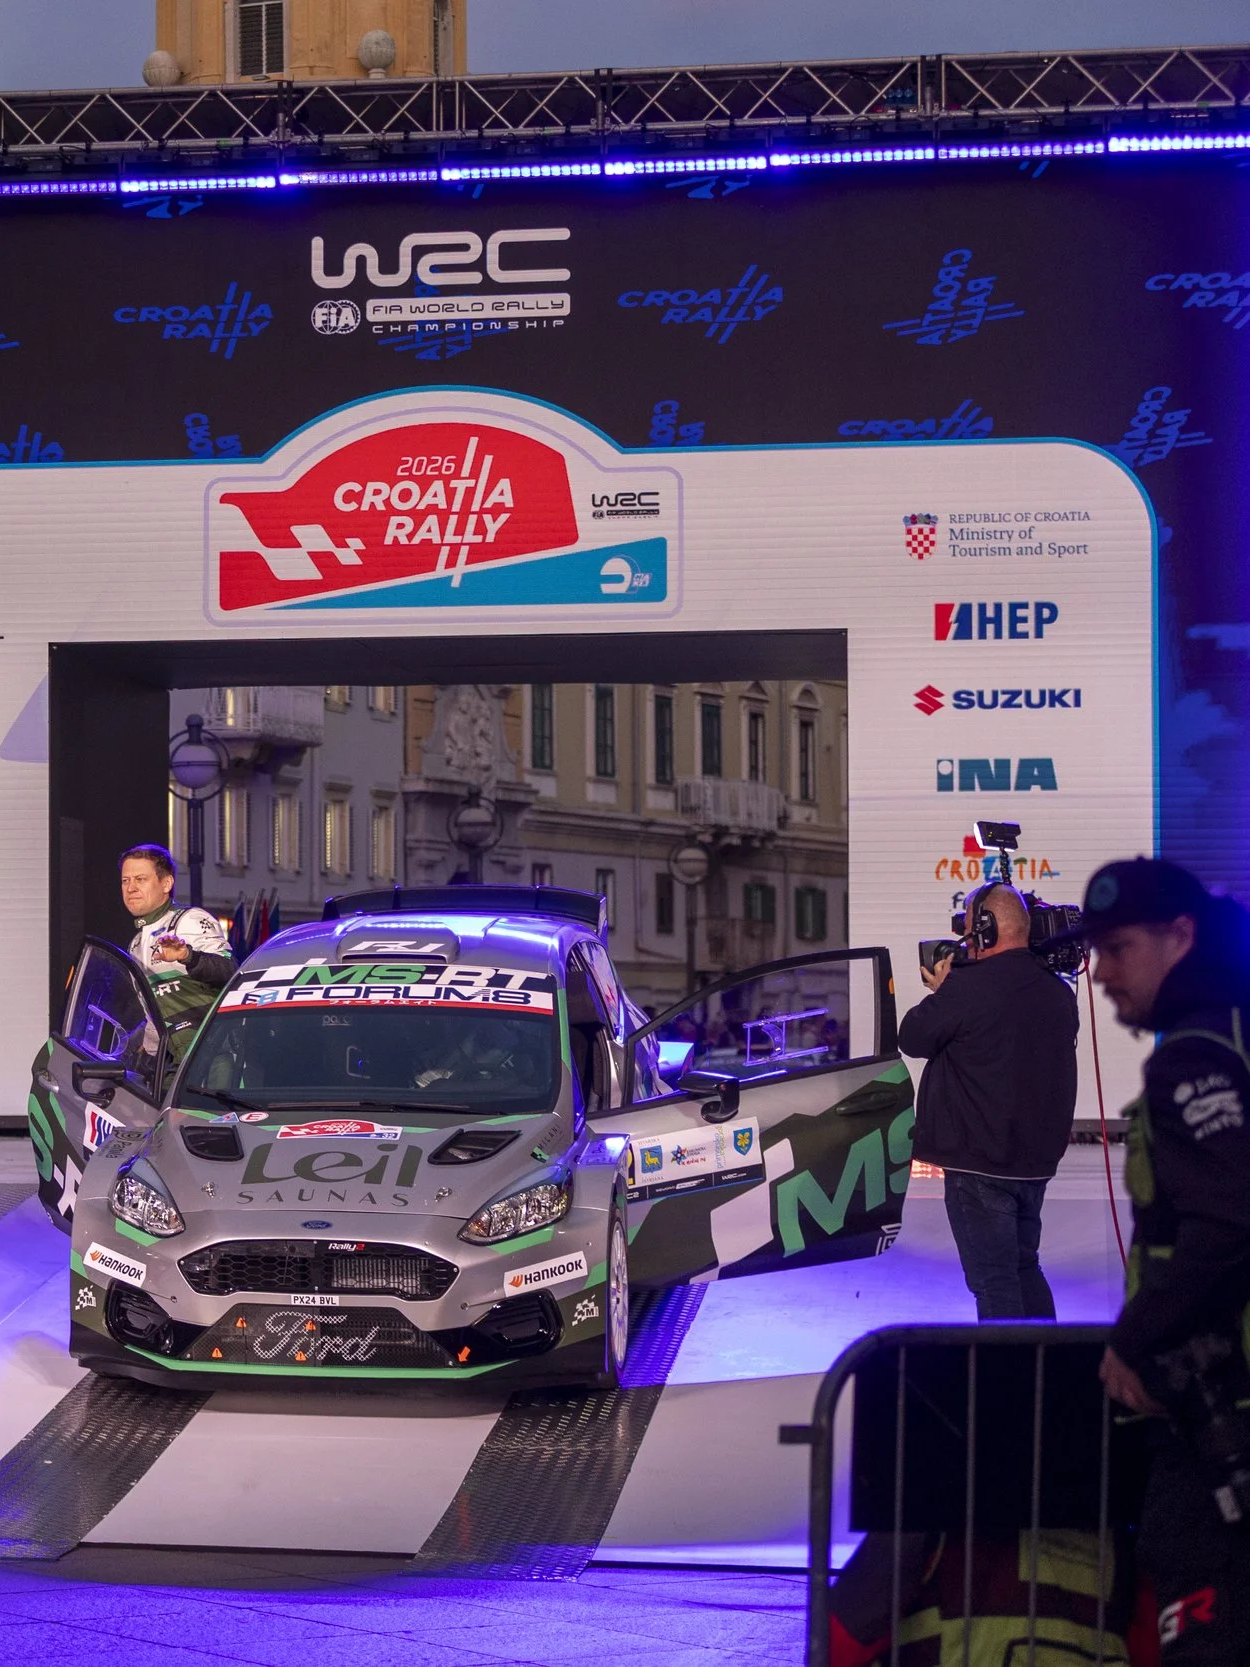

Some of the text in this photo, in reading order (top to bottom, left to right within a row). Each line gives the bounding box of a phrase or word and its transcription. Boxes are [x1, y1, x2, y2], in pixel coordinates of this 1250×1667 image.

[311, 227, 571, 289] WRC
[1145, 272, 1250, 290] CROA
[617, 275, 784, 307] CROATIA
[114, 293, 273, 323] CROATIA
[372, 299, 565, 315] FIA WORLD RALLY
[660, 306, 778, 325] RALLY
[162, 322, 270, 340] RALLY
[372, 319, 565, 333] CHAMPIONSHIP
[396, 455, 457, 477] 2026
[333, 455, 515, 513] CROATIA
[592, 492, 660, 508] WRC
[949, 511, 1091, 524] REPUBLIC OF CROATIA
[384, 513, 510, 546] RALLY
[949, 526, 1036, 542] Ministry of
[948, 542, 1089, 559] Tourism and Sport
[977, 601, 1059, 640] HEP
[952, 688, 1081, 710] SUZUKI
[292, 964, 551, 991] MS-RT
[285, 986, 532, 1005] FORUM8
[236, 1189, 410, 1208] SAUNAS
[328, 1242, 365, 1252] Rally2
[99, 1253, 145, 1281] HANKOOK
[524, 1258, 584, 1285] HANKOOK
[293, 1296, 337, 1305] PX24 BVL
